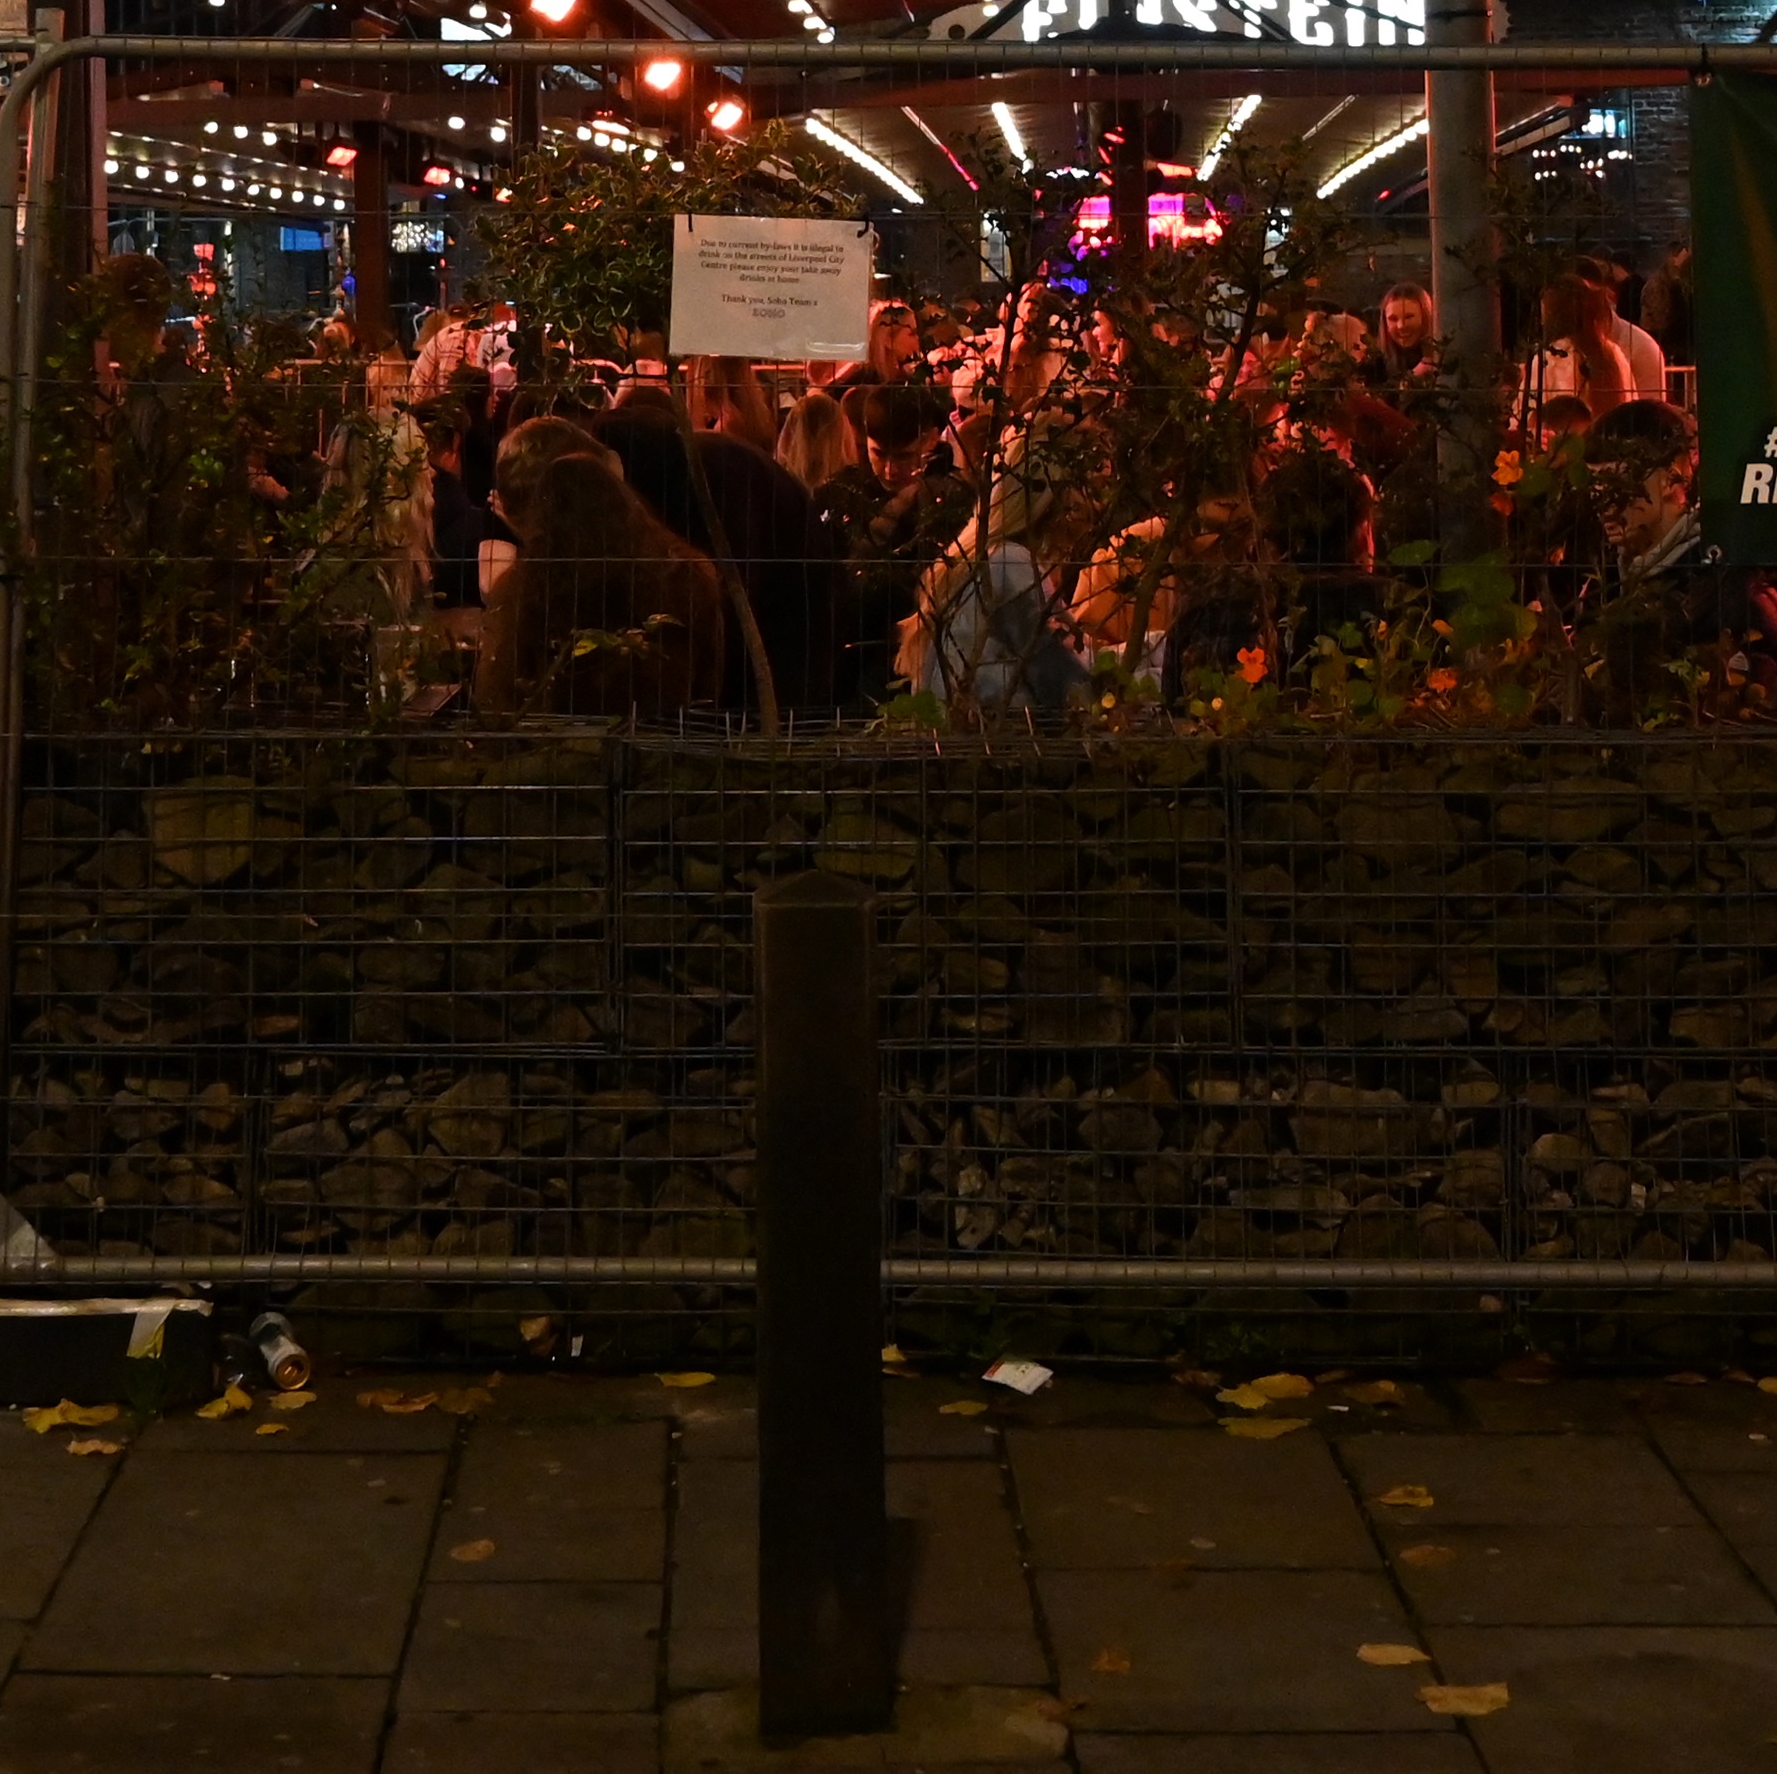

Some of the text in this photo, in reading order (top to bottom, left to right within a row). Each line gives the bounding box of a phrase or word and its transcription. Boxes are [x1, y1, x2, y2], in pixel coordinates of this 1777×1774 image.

[789, 254, 826, 263] Liverpool
[828, 255, 844, 264] City
[722, 294, 745, 302] Thank
[767, 297, 787, 305] Soho
[789, 297, 811, 305] Team
